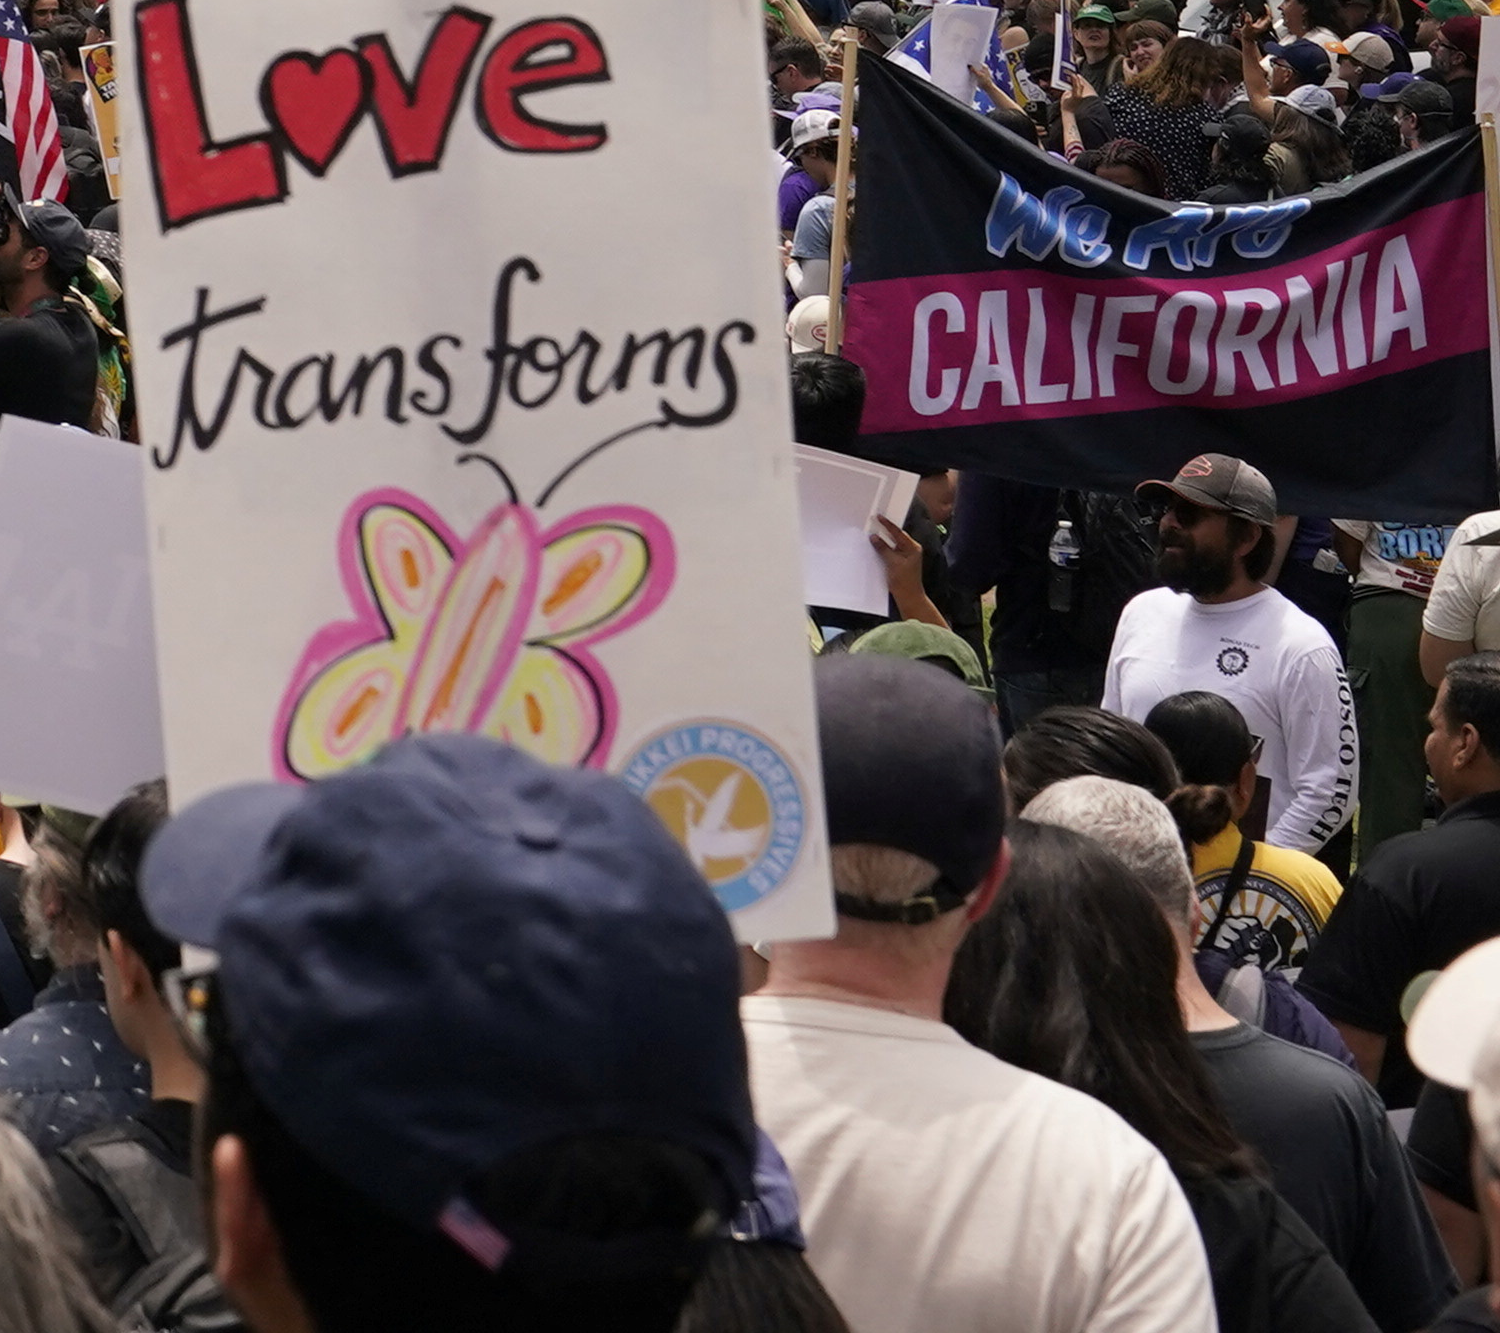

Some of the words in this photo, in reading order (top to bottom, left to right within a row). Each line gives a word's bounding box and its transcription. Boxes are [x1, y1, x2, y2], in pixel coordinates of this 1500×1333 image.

[985, 171, 1113, 269] We
[151, 256, 756, 471] transforms
[907, 234, 1429, 416] CALIFORNIA
[1335, 666, 1357, 766] BOSCO
[623, 734, 692, 789] IKKEI
[700, 728, 801, 894] PROGRESSIVES
[1308, 777, 1351, 843] TECH
